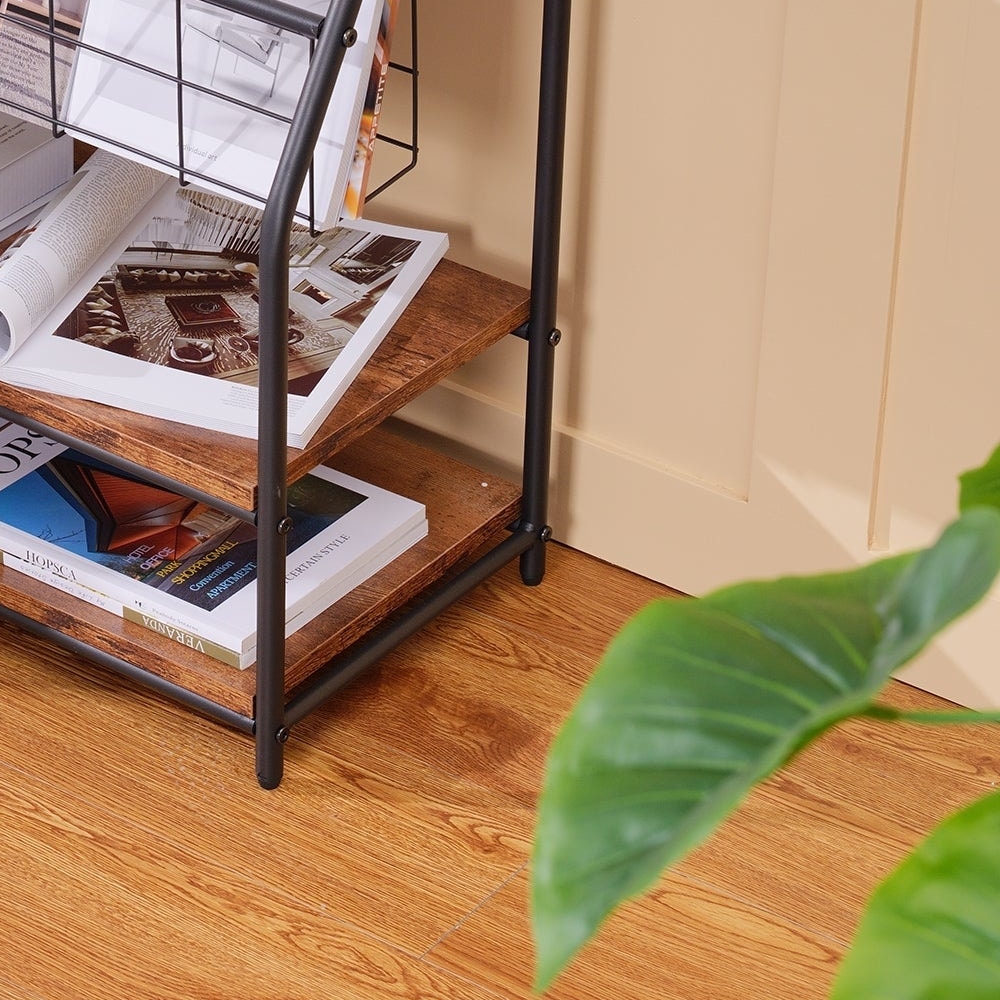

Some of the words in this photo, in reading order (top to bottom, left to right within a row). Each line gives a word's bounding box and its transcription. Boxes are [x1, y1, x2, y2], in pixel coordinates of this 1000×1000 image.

[368, 63, 389, 152] APPETITE
[26, 550, 77, 581] HOPSCA
[123, 544, 155, 564] HOTEL
[140, 546, 175, 571] OFFICE
[156, 560, 182, 578] PARK
[285, 552, 323, 581] CERTAIN
[320, 534, 351, 556] STYLE
[189, 560, 235, 592] Convention
[206, 561, 257, 600] APARTMENT
[142, 615, 206, 654] VERANDA
